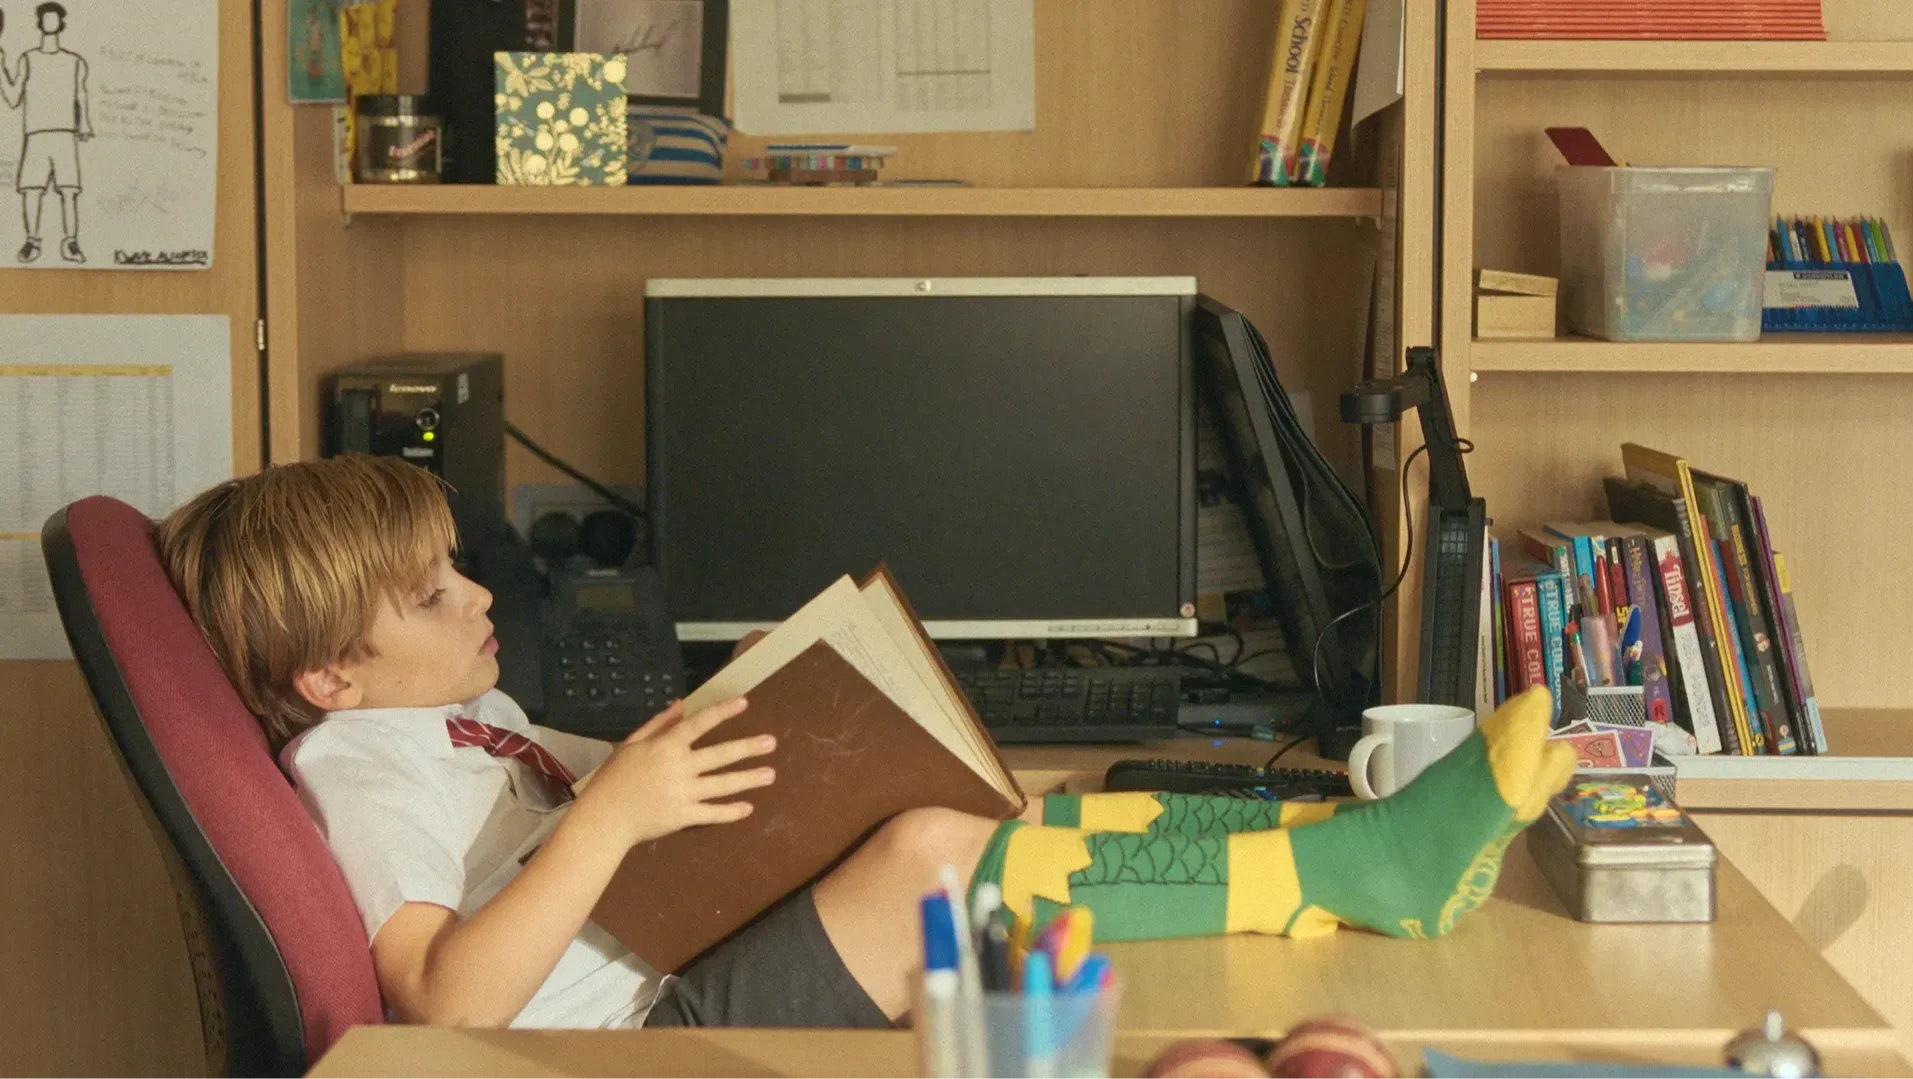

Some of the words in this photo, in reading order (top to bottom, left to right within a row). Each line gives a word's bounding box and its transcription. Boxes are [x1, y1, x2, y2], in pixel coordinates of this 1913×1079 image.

[1286, 15, 1311, 73] School
[1545, 588, 1560, 633] TRUE
[1664, 564, 1690, 619] Tinsel
[1521, 594, 1538, 643] TRUE
[1527, 648, 1542, 686] COL
[1551, 635, 1563, 711] COLO
